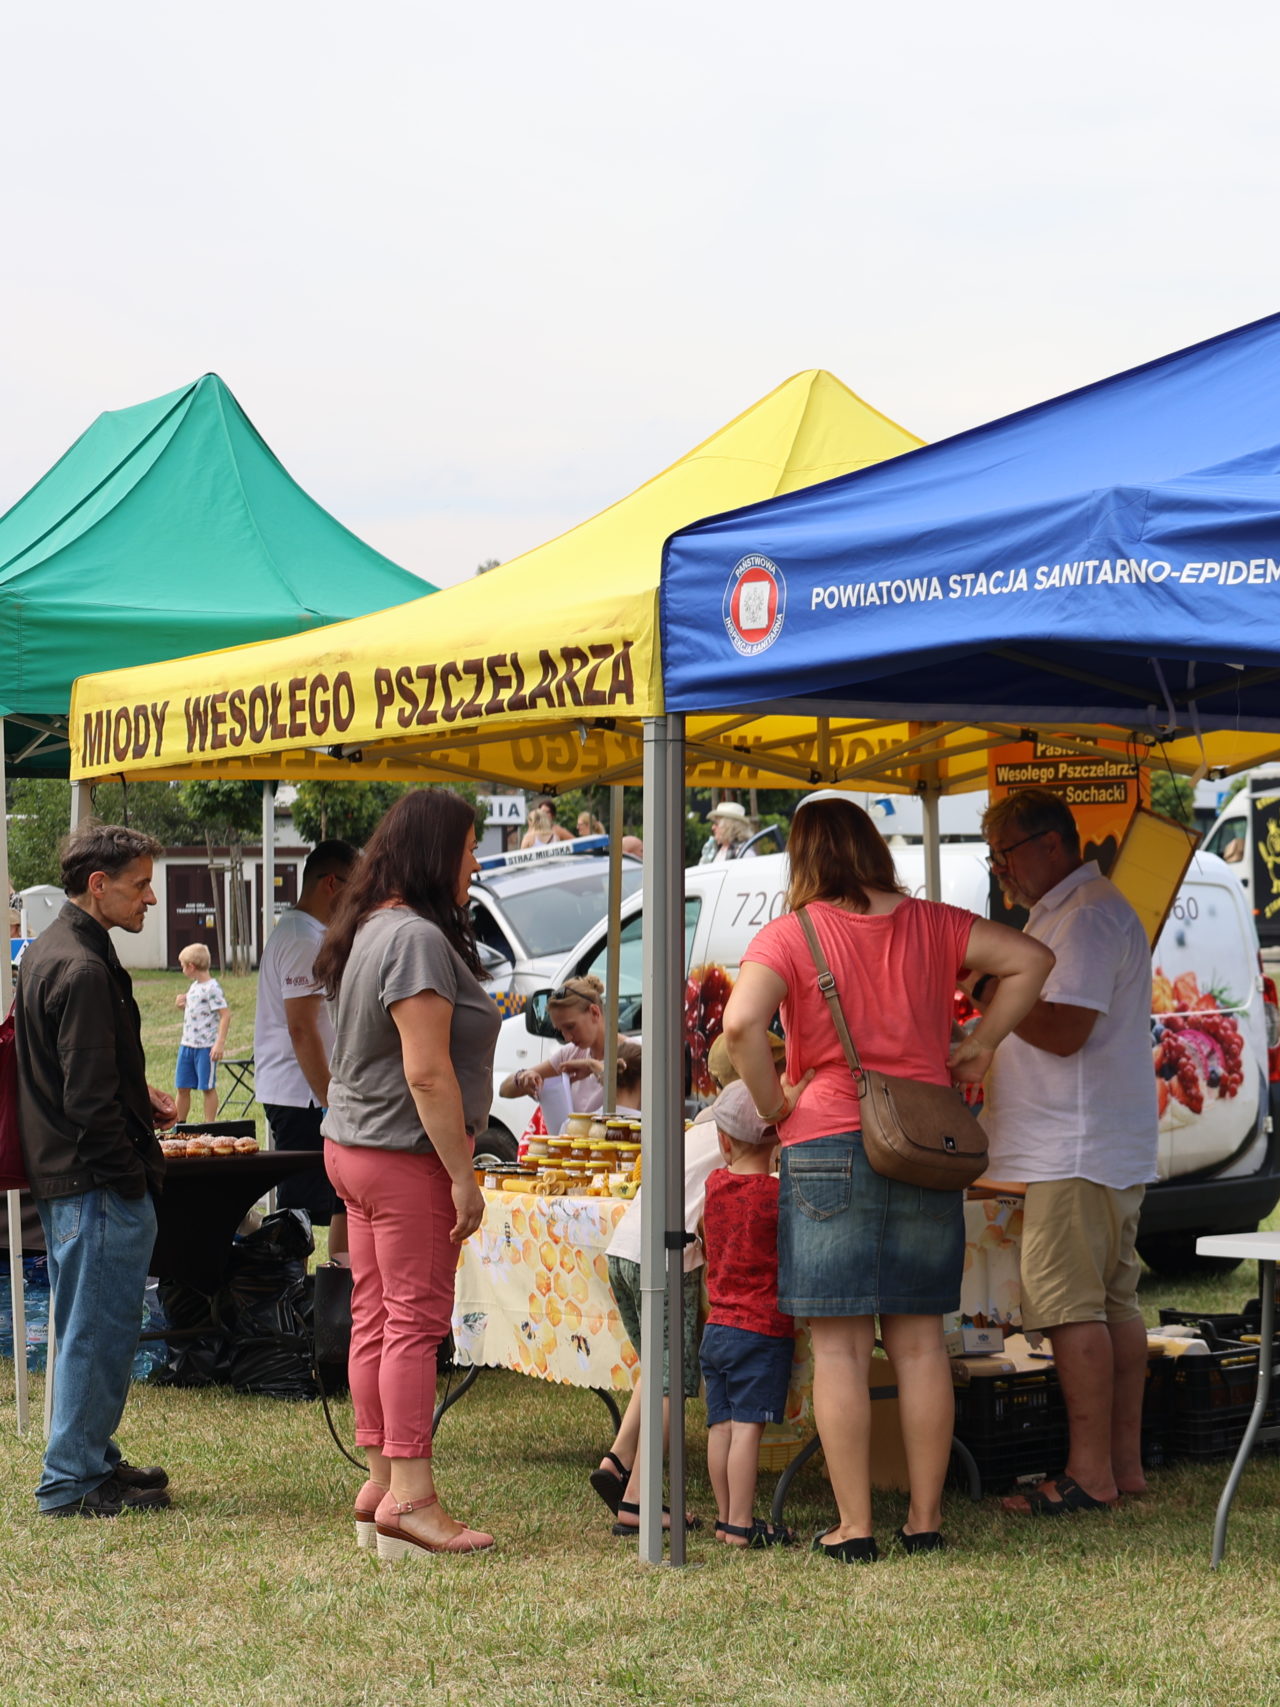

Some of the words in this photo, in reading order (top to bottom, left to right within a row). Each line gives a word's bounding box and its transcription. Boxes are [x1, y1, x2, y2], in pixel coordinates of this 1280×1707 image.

[811, 576, 943, 610] POWIATOWA
[948, 568, 1028, 599] STACJA
[725, 617, 751, 654] INSPEKCJA
[752, 613, 783, 654] SANITARNA
[81, 701, 170, 768] MIODY
[184, 671, 355, 754] WESOŁEGO
[374, 640, 634, 729] PSZCZELARZA
[1066, 785, 1125, 803] Sochacki
